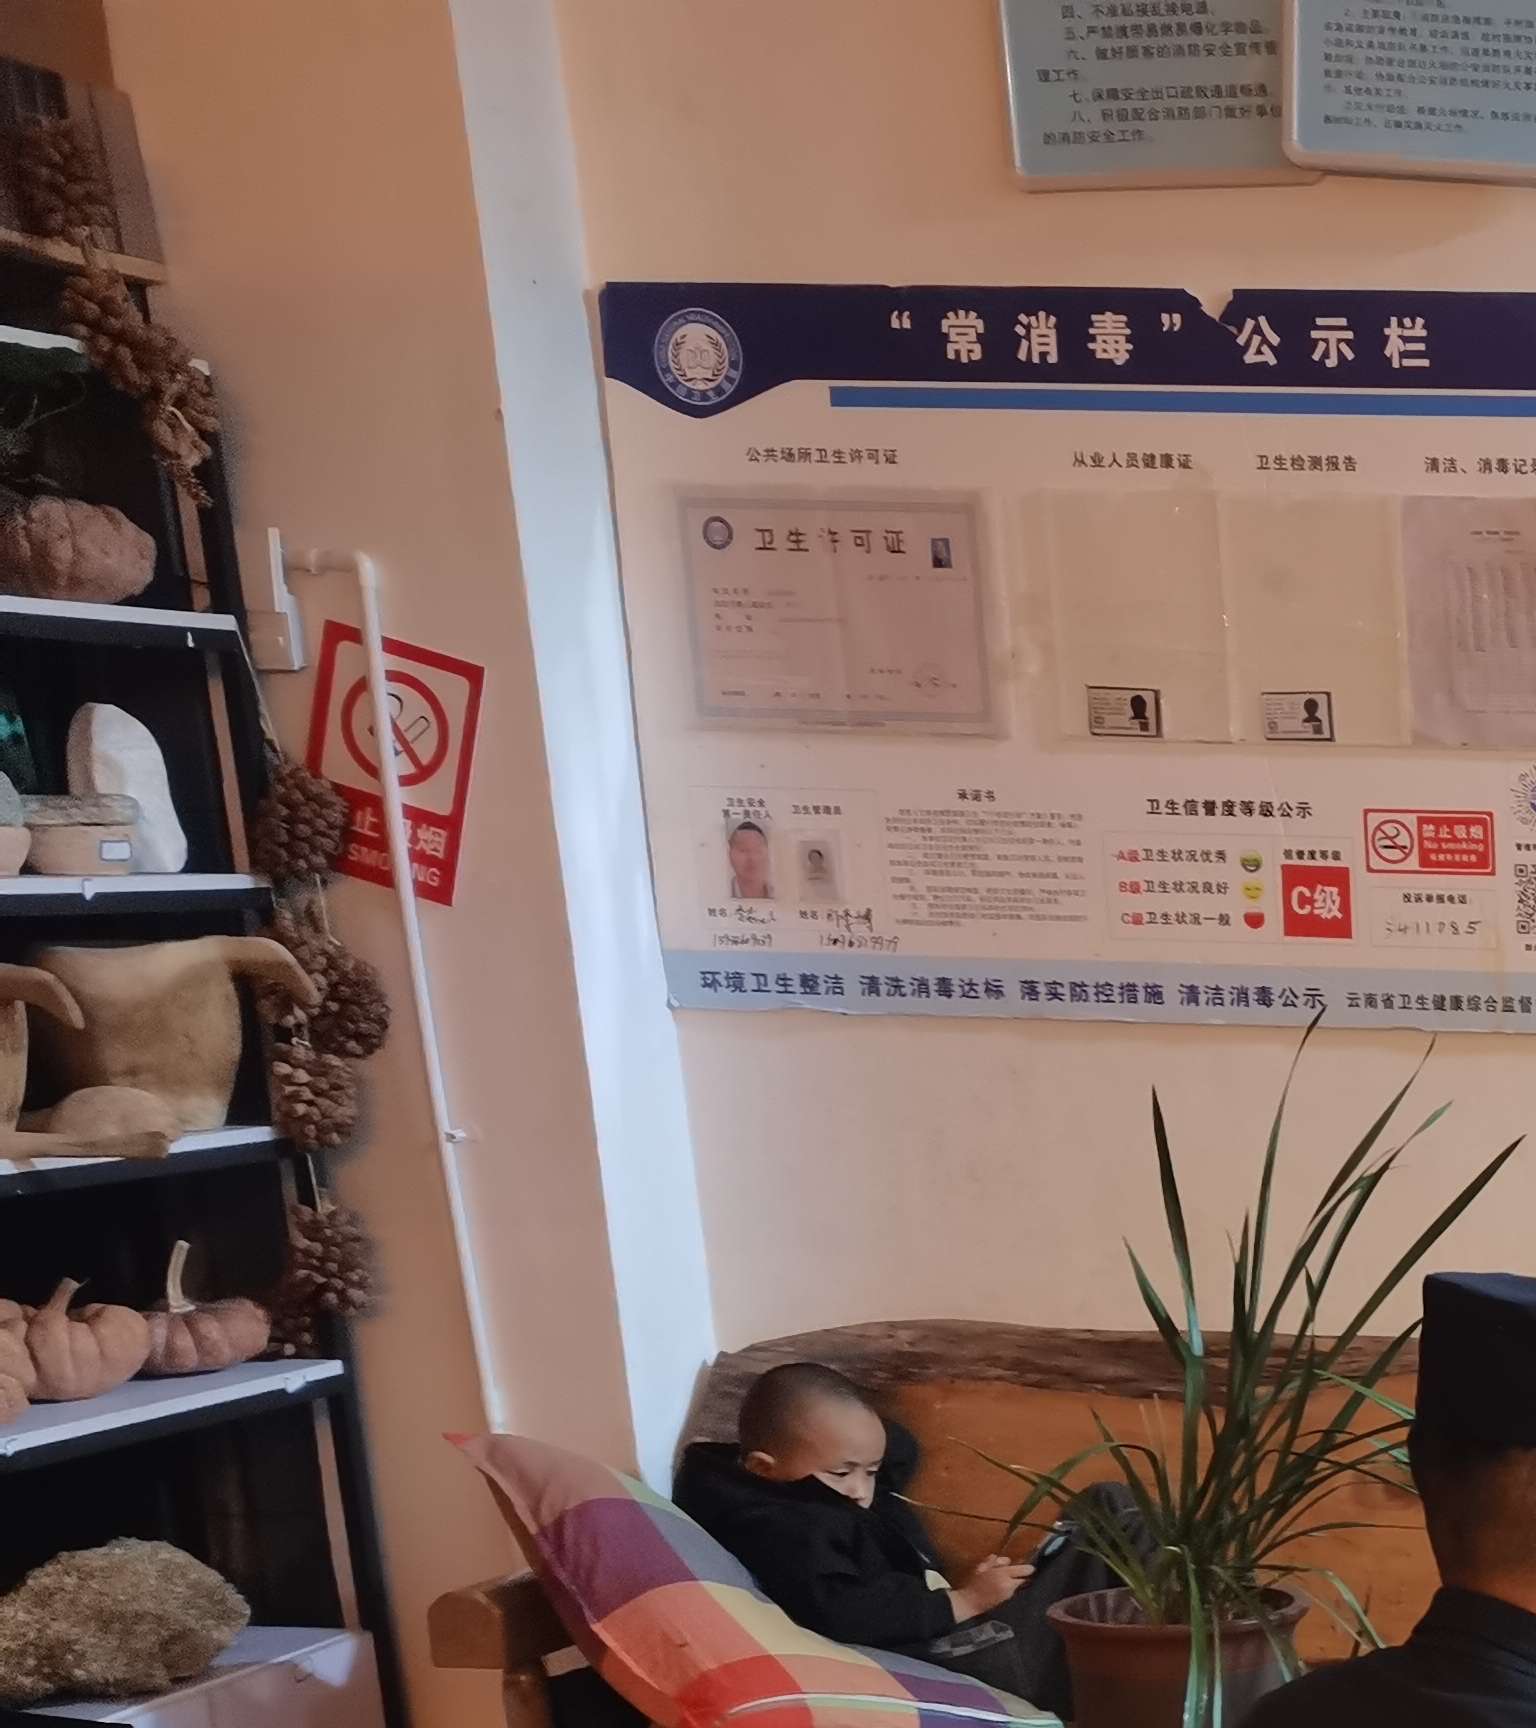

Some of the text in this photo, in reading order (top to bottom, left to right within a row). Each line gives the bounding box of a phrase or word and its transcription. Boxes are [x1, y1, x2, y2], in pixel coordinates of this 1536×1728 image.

[746, 447, 899, 464] 公共场所卫生许可证
[1072, 451, 1194, 471] 从业人员健康证
[1255, 453, 1359, 473] 卫生检测报告
[754, 527, 906, 554] 卫生许可证
[1146, 798, 1313, 819] 卫生信誉度等级公示
[1291, 883, 1343, 921] C级
[700, 970, 846, 997] 环境卫生整洁
[859, 973, 1007, 1001] 清洗消毒达标
[1020, 979, 1165, 1006] 落实防控措施
[1178, 983, 1326, 1010] 清洁消毒公示
